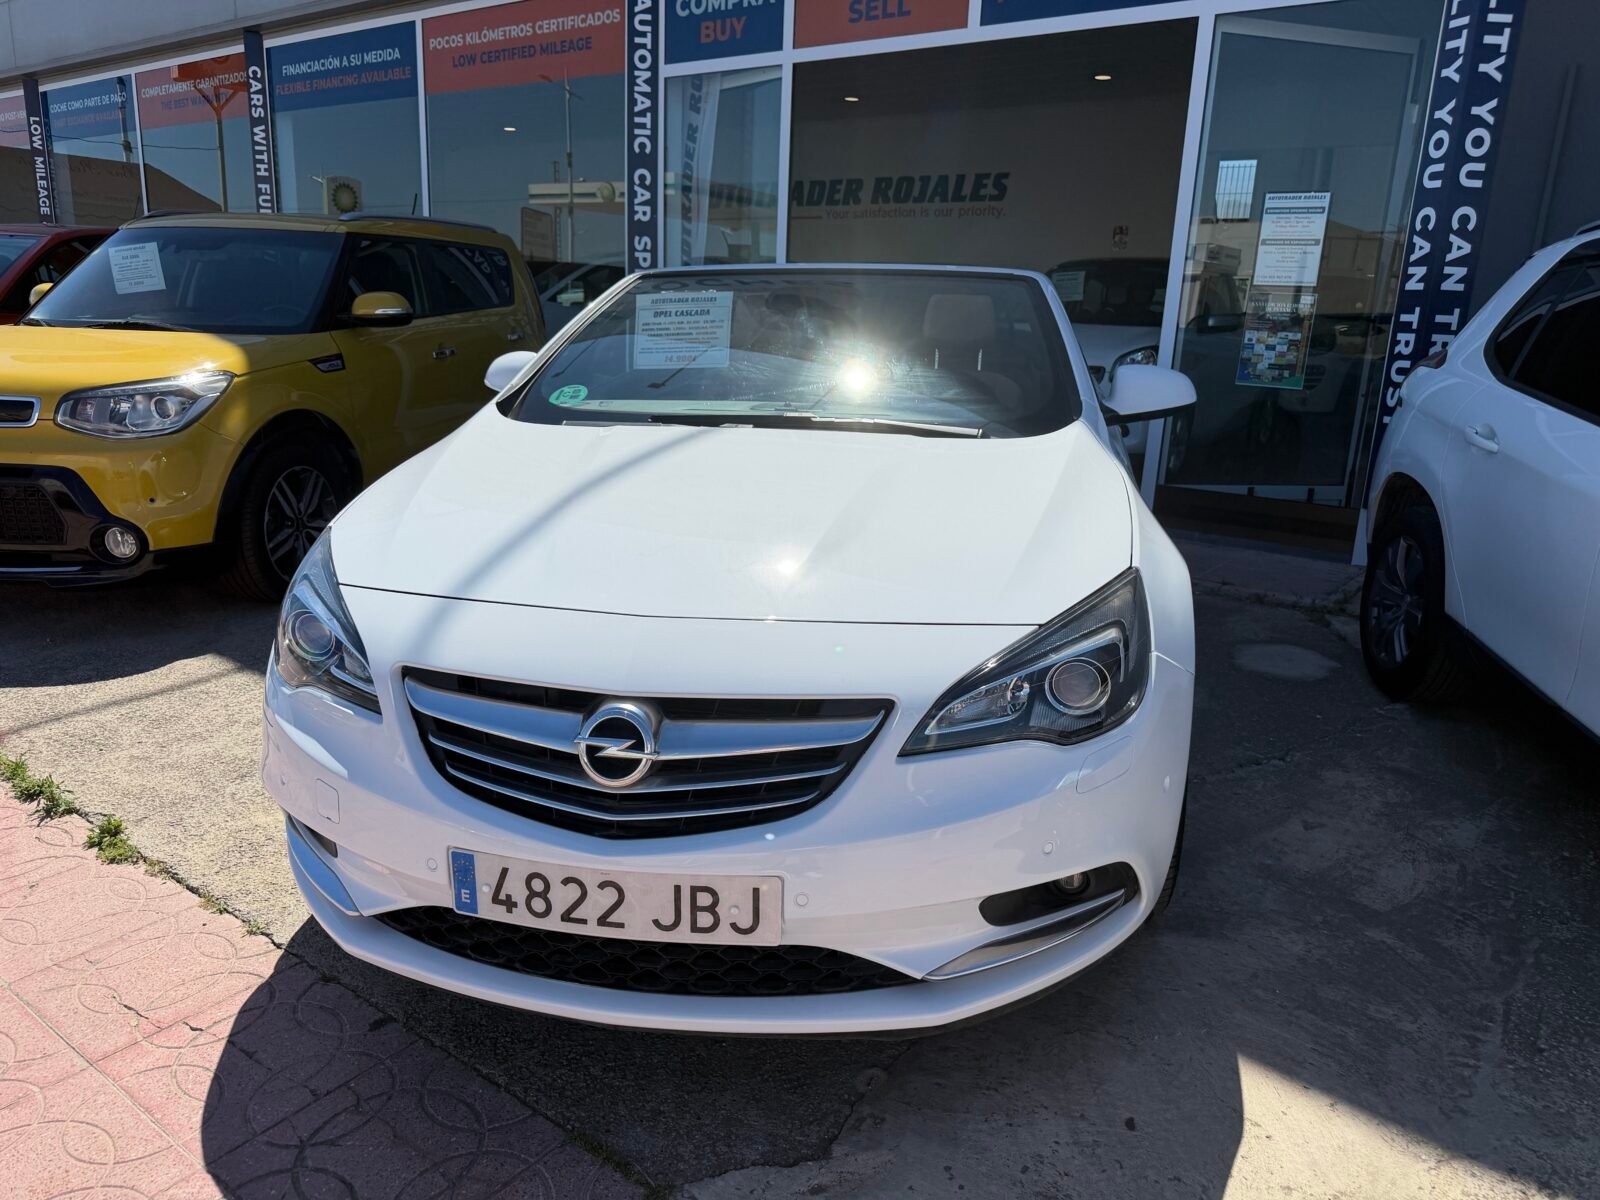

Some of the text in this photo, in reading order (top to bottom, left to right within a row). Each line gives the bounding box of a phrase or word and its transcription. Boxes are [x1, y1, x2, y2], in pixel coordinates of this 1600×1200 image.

[675, 0, 776, 17] COM
[847, 0, 911, 24] SELL
[429, 9, 621, 50] POCOS KILÓMETROS CERTIFICADOS
[700, 16, 747, 44] BUY
[1477, 0, 1514, 83] ITY
[282, 47, 401, 77] FINANCIACIÓN A SU MEDIDA
[452, 36, 593, 68] LOW CERTIFIED MILEAGE
[141, 80, 195, 98] COMPLETAMENTE
[248, 65, 265, 118] CARS
[275, 66, 412, 96] FLEXIBLE FINANCING AVAILABLE
[50, 91, 127, 114] COCHE COMO PARTE DE PAGO
[252, 125, 269, 177] WITH
[633, 0, 652, 273] AUTOMATIC CAR SP
[1422, 97, 1456, 189] YOU
[1458, 97, 1499, 188] YOU
[29, 116, 51, 215] LOW MILEAGE
[870, 172, 1011, 205] ROJALES
[825, 203, 1007, 220] Your satisfaction is our priority.
[1404, 206, 1437, 291] CAN
[1440, 205, 1477, 292] CAN
[653, 309, 711, 318] OPEL CASCADA
[1382, 307, 1420, 424] TRUS
[461, 889, 471, 903] E
[491, 866, 760, 935] 4822 JBJ
